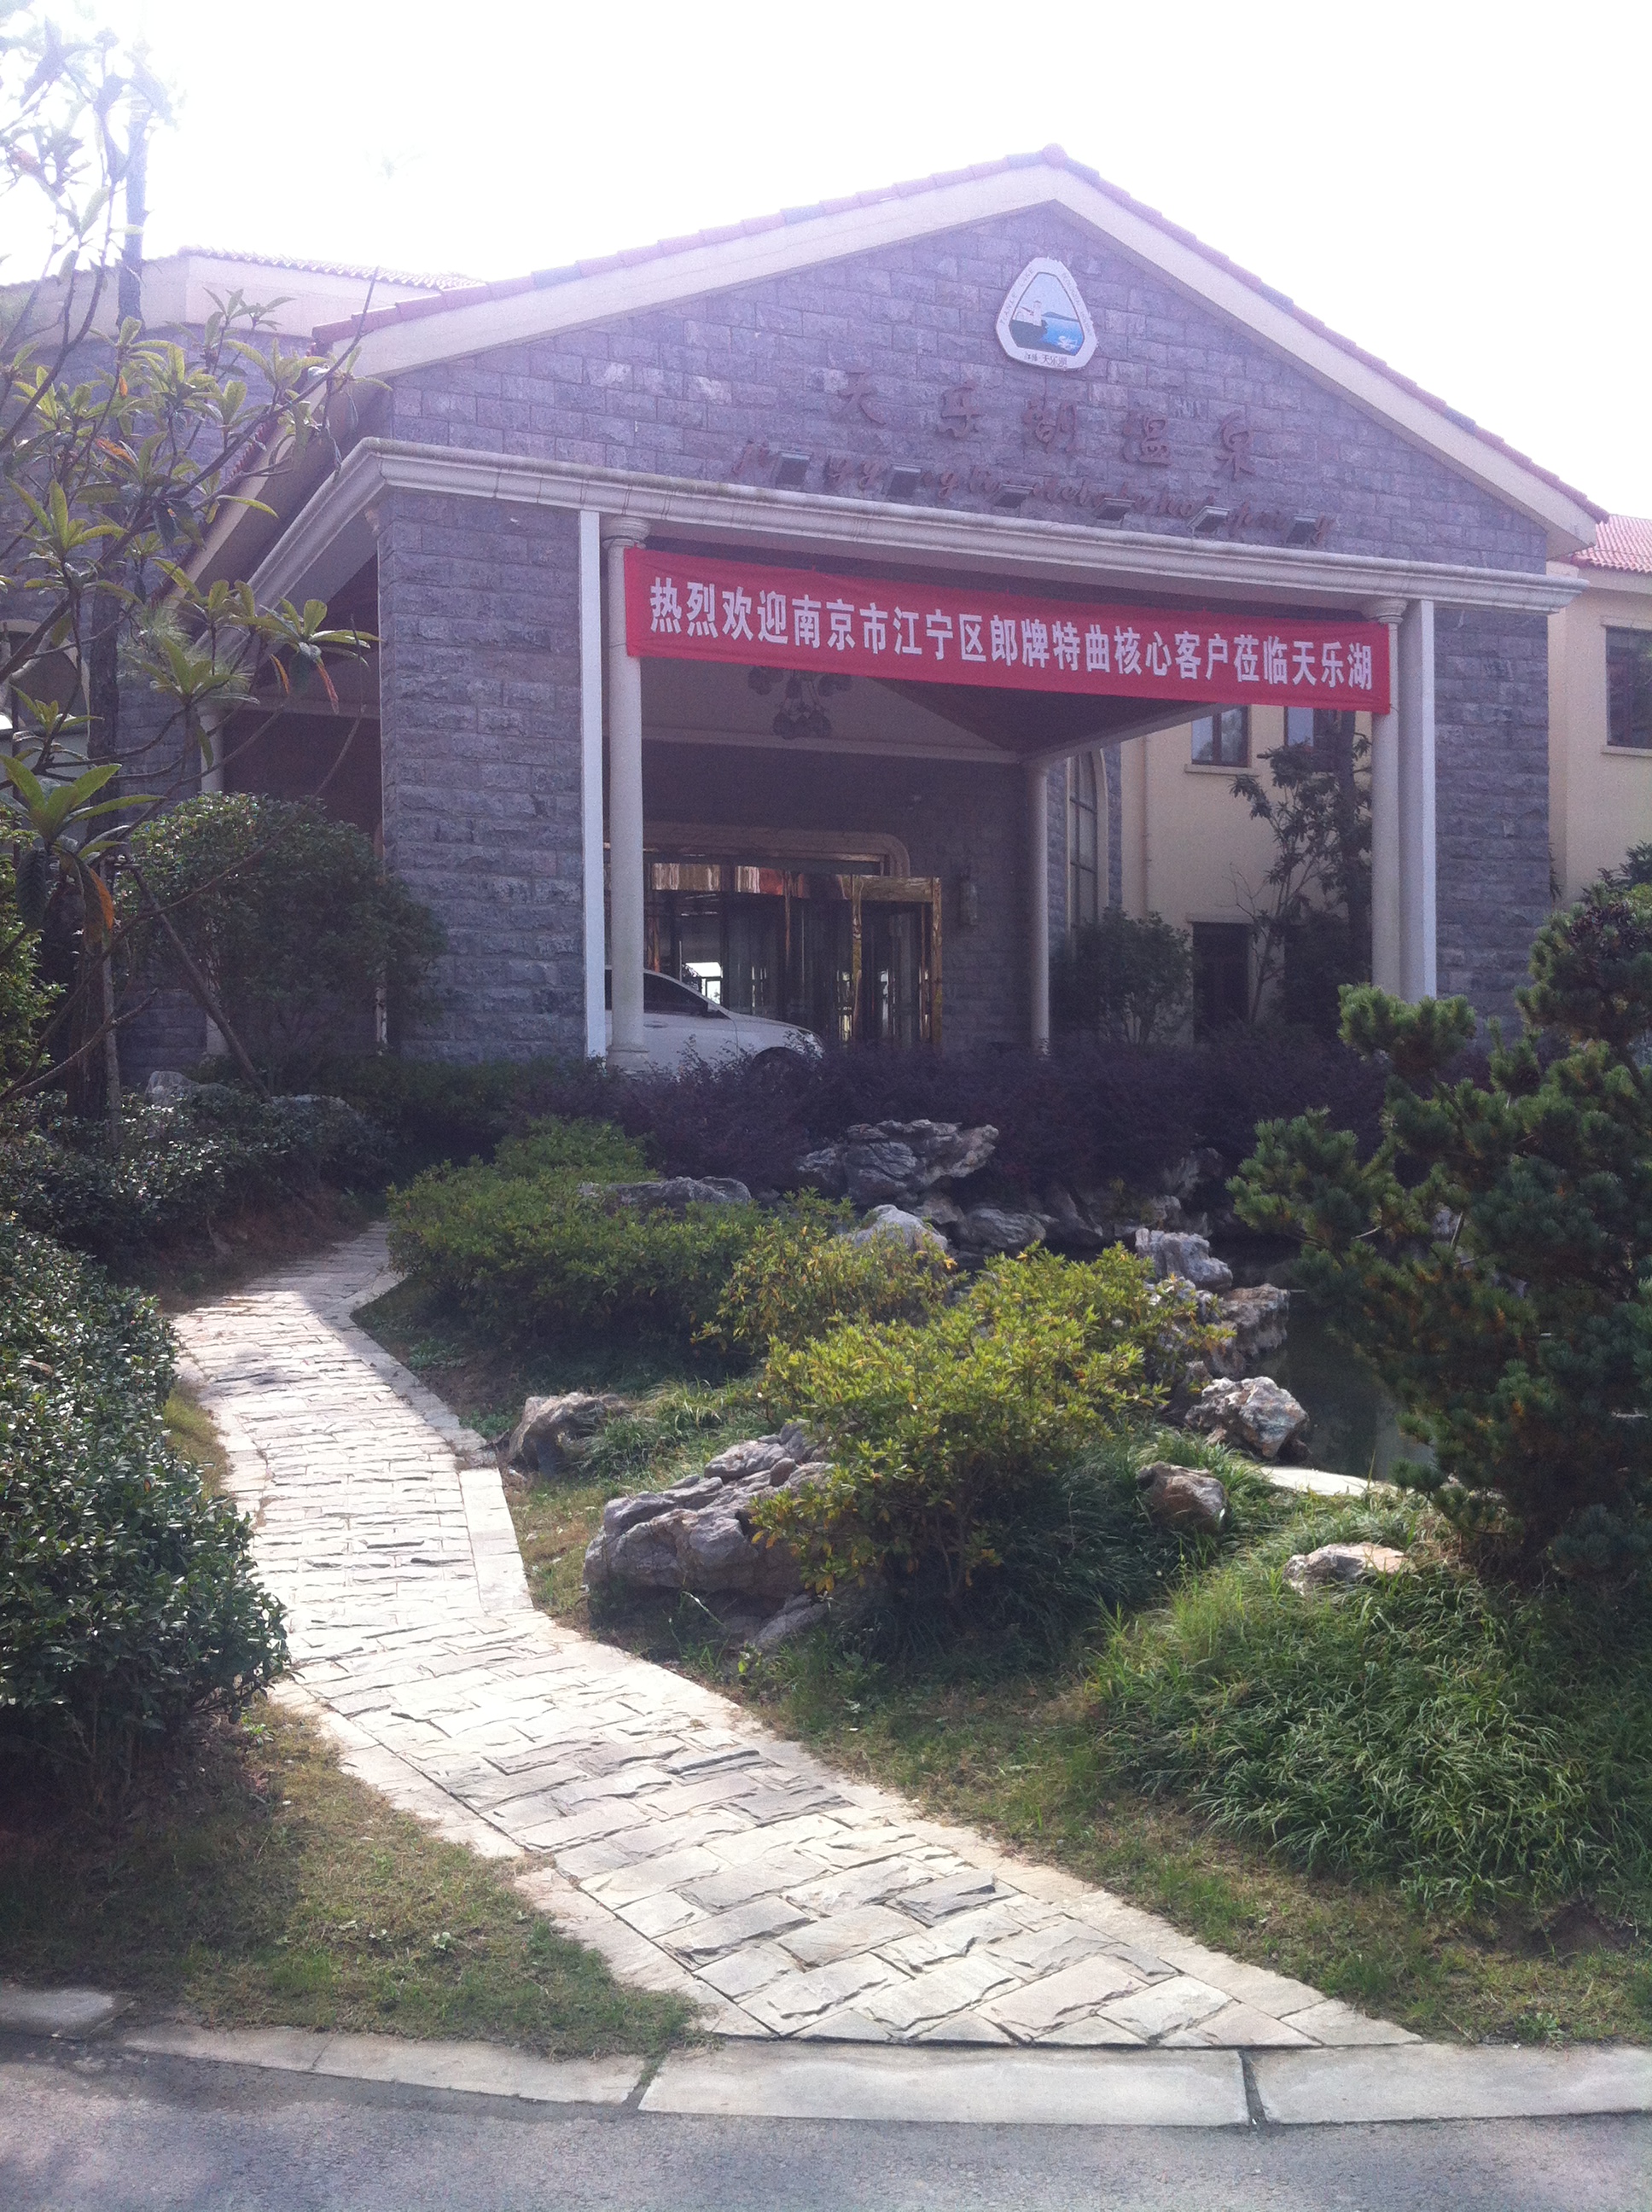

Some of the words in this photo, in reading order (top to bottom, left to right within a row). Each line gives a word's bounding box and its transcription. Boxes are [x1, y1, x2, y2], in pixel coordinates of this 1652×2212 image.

[649, 576, 1373, 690] 热烈欢迎南京市江宁区郎牌特曲核心客户莅临天乐湖
